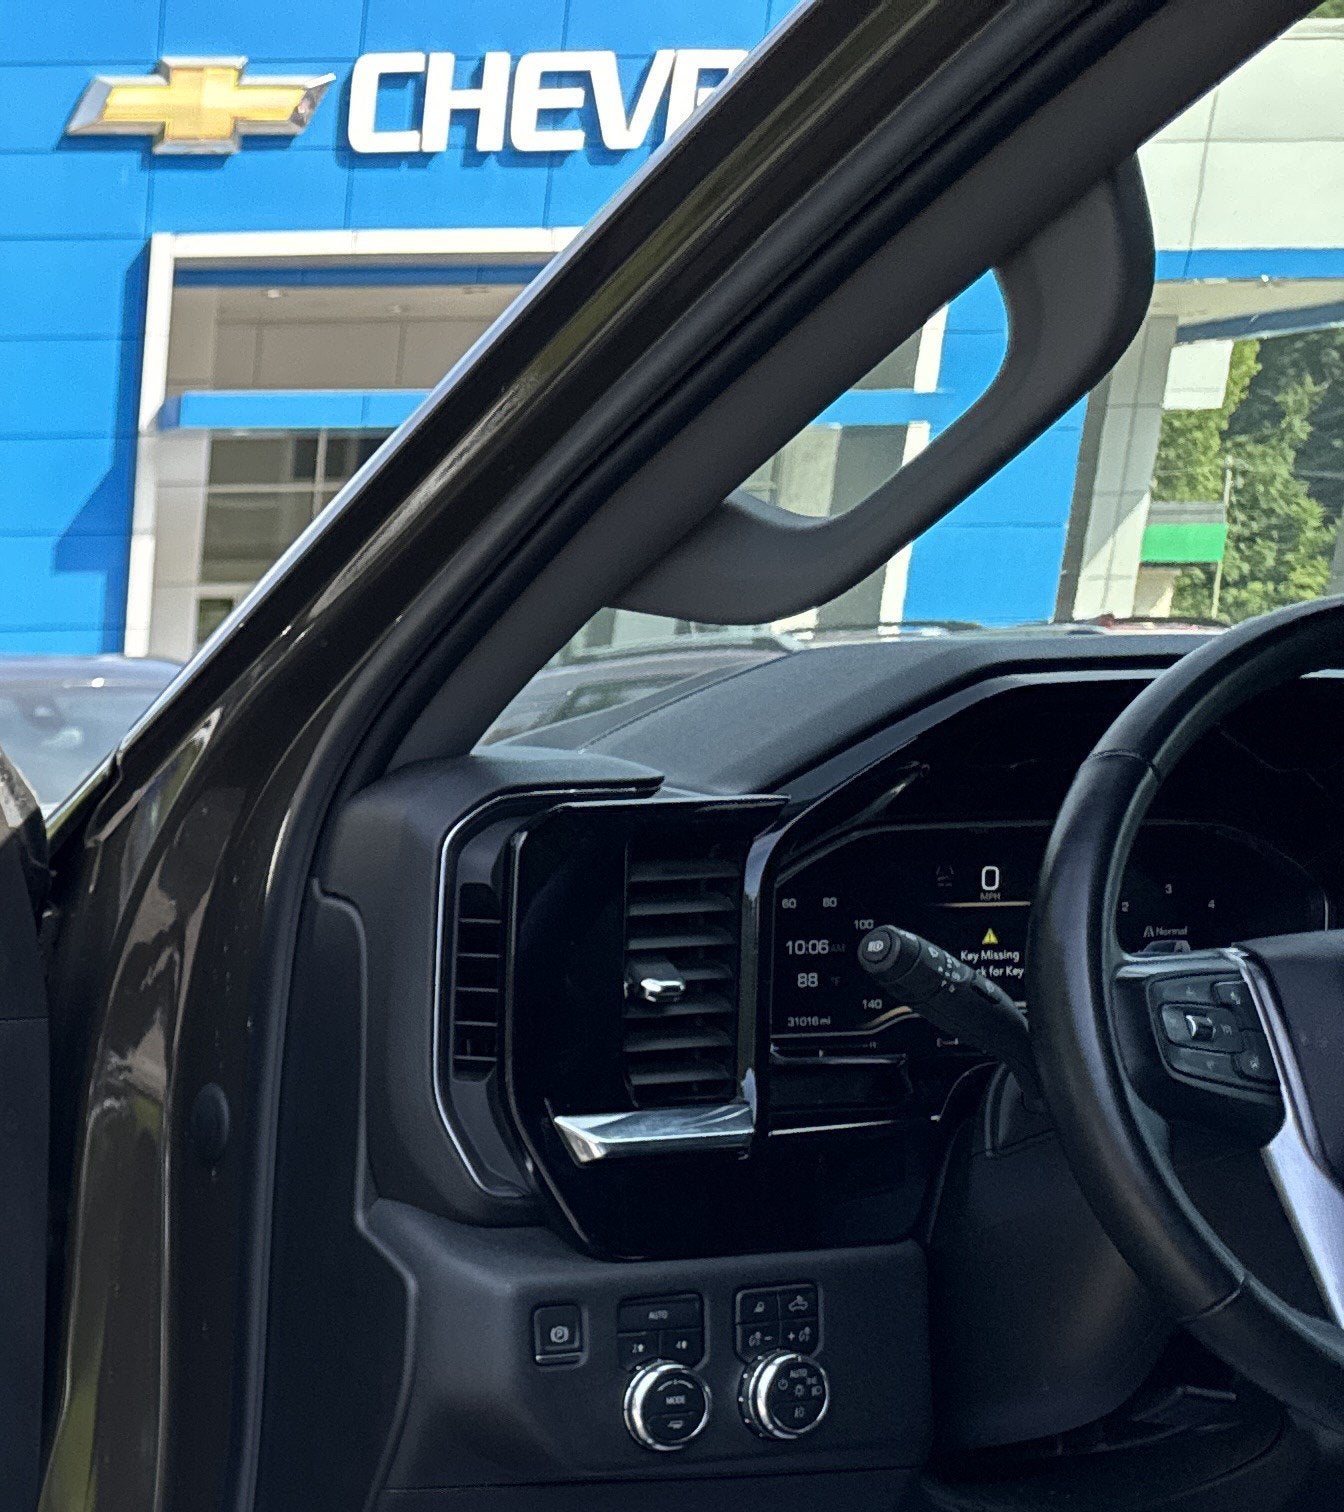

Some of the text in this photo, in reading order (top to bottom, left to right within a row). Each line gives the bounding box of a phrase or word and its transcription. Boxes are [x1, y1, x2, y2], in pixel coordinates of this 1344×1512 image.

[981, 865, 1000, 891] 0
[854, 919, 874, 930] 100
[785, 939, 829, 955] 10:06
[960, 949, 1020, 964] Key Missing
[988, 964, 1004, 977] for
[1005, 965, 1025, 979] Key
[797, 972, 819, 988] 88
[862, 999, 883, 1010] 140
